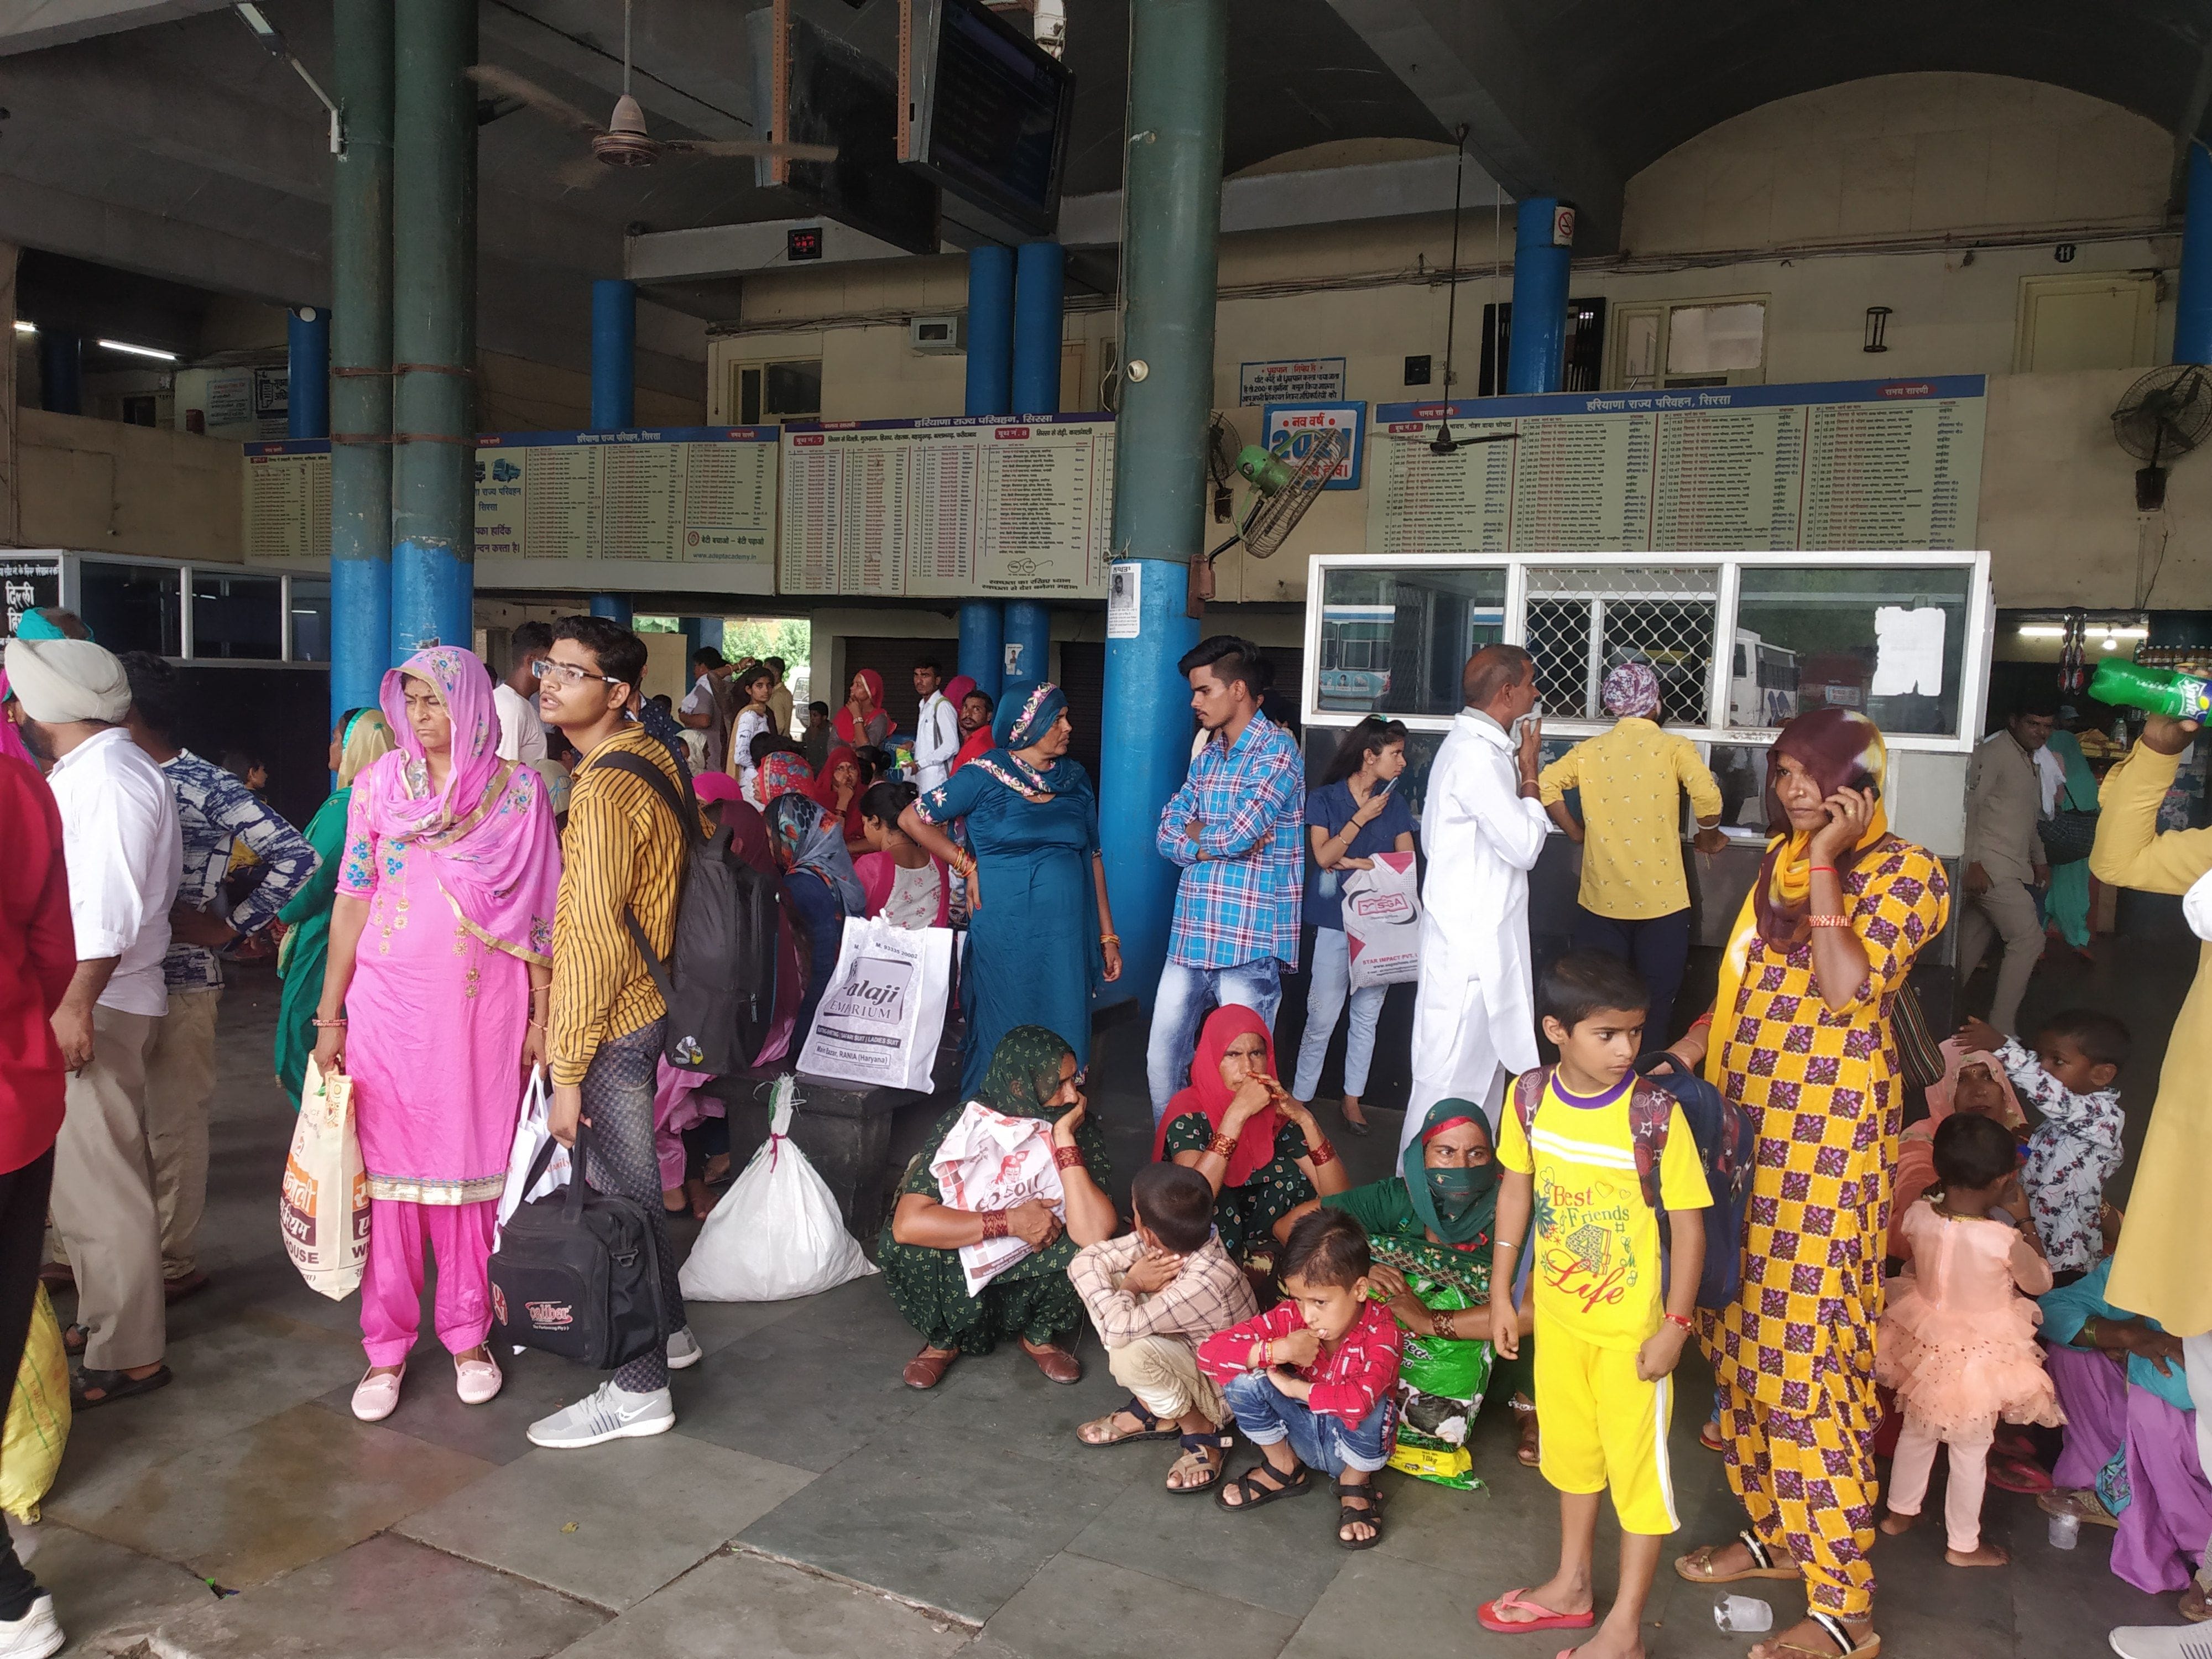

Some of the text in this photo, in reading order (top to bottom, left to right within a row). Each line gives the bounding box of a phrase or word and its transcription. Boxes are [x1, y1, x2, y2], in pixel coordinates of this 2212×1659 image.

[2059, 247, 2070, 260] 11
[1885, 384, 1929, 396] समय सारणी
[1586, 392, 1731, 411] हरियाणा राज्य परिवहन, सिरसा
[1436, 407, 1454, 416] साणी
[914, 418, 951, 427] हरियाणा
[953, 417, 976, 425] राज्य
[1023, 413, 1053, 423] सिरसा
[1292, 412, 1325, 427] नव वर्ष
[577, 434, 599, 443] हरियाणा
[641, 431, 661, 441] सिरसा
[796, 436, 807, 445] बूथ
[998, 429, 1010, 438] बूथ
[482, 487, 496, 496] राज्य
[499, 485, 521, 497] परिवहन
[479, 501, 498, 512] सिरसा
[475, 526, 488, 536] पका
[701, 534, 711, 544] बेटी
[712, 535, 729, 544] बचाओ
[737, 535, 747, 545] बेटी
[492, 544, 510, 552] करता
[5, 580, 34, 609] दिल्ली
[2182, 679, 2201, 716] Sprite
[884, 945, 900, 954] 93335
[901, 950, 918, 959] 20002
[843, 979, 900, 1005] alaji
[830, 1000, 891, 1019] EMRIUM
[826, 1047, 838, 1057] Bazar,
[839, 1051, 857, 1060] RANIA
[858, 1054, 888, 1065] (Haryana)
[1553, 1185, 1594, 1207] Best
[1567, 1205, 1630, 1227] Friends
[1566, 1223, 1611, 1276] 4
[1543, 1248, 1625, 1313] Life
[1422, 1454, 1438, 1465] 10kg
